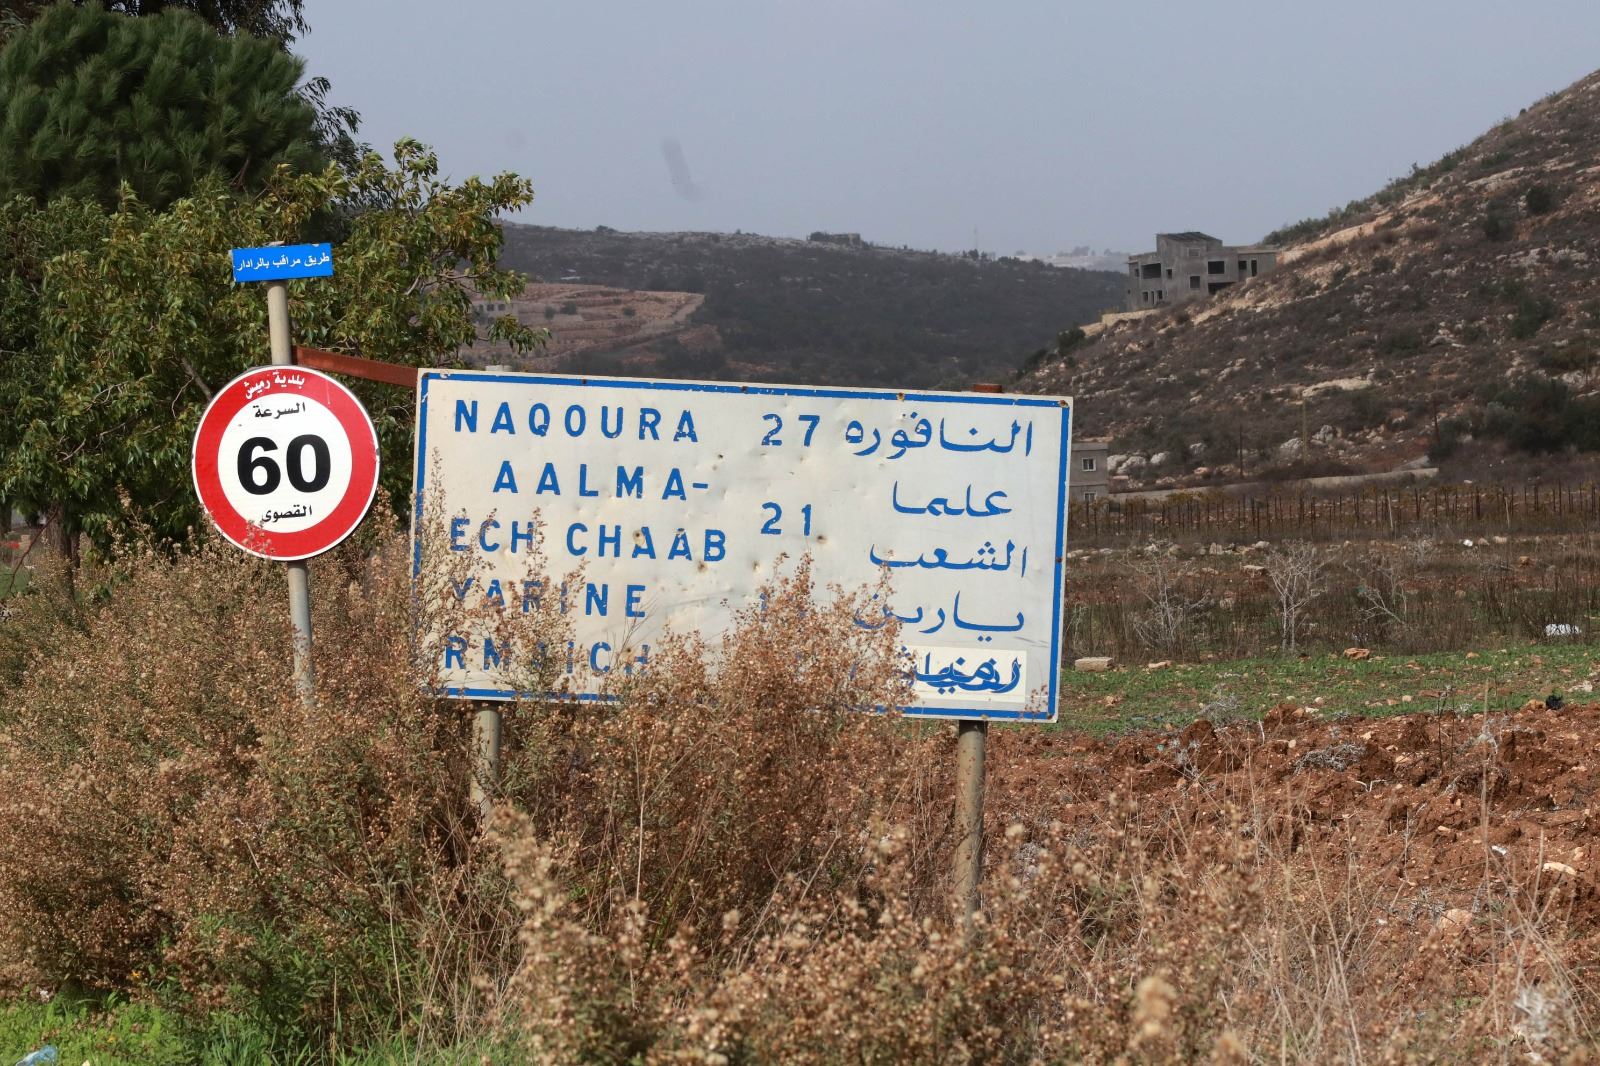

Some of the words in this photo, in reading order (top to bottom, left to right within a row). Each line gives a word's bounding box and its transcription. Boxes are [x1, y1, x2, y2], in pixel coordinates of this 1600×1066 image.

[236, 257, 270, 272] بالرادار
[271, 254, 301, 268] مراقب
[303, 251, 331, 268] طريق
[243, 379, 271, 400] رميش
[272, 371, 306, 390] بلدية
[252, 401, 306, 420] السرعة
[454, 399, 699, 443] NAQOURA
[761, 413, 821, 447] 27
[236, 433, 332, 496] 60
[892, 480, 1012, 517] علما
[261, 504, 313, 524] القصوى
[450, 517, 534, 554] ECH
[566, 522, 727, 563] CHAAB
[760, 501, 812, 537] 21
[869, 539, 1028, 578] الشعب
